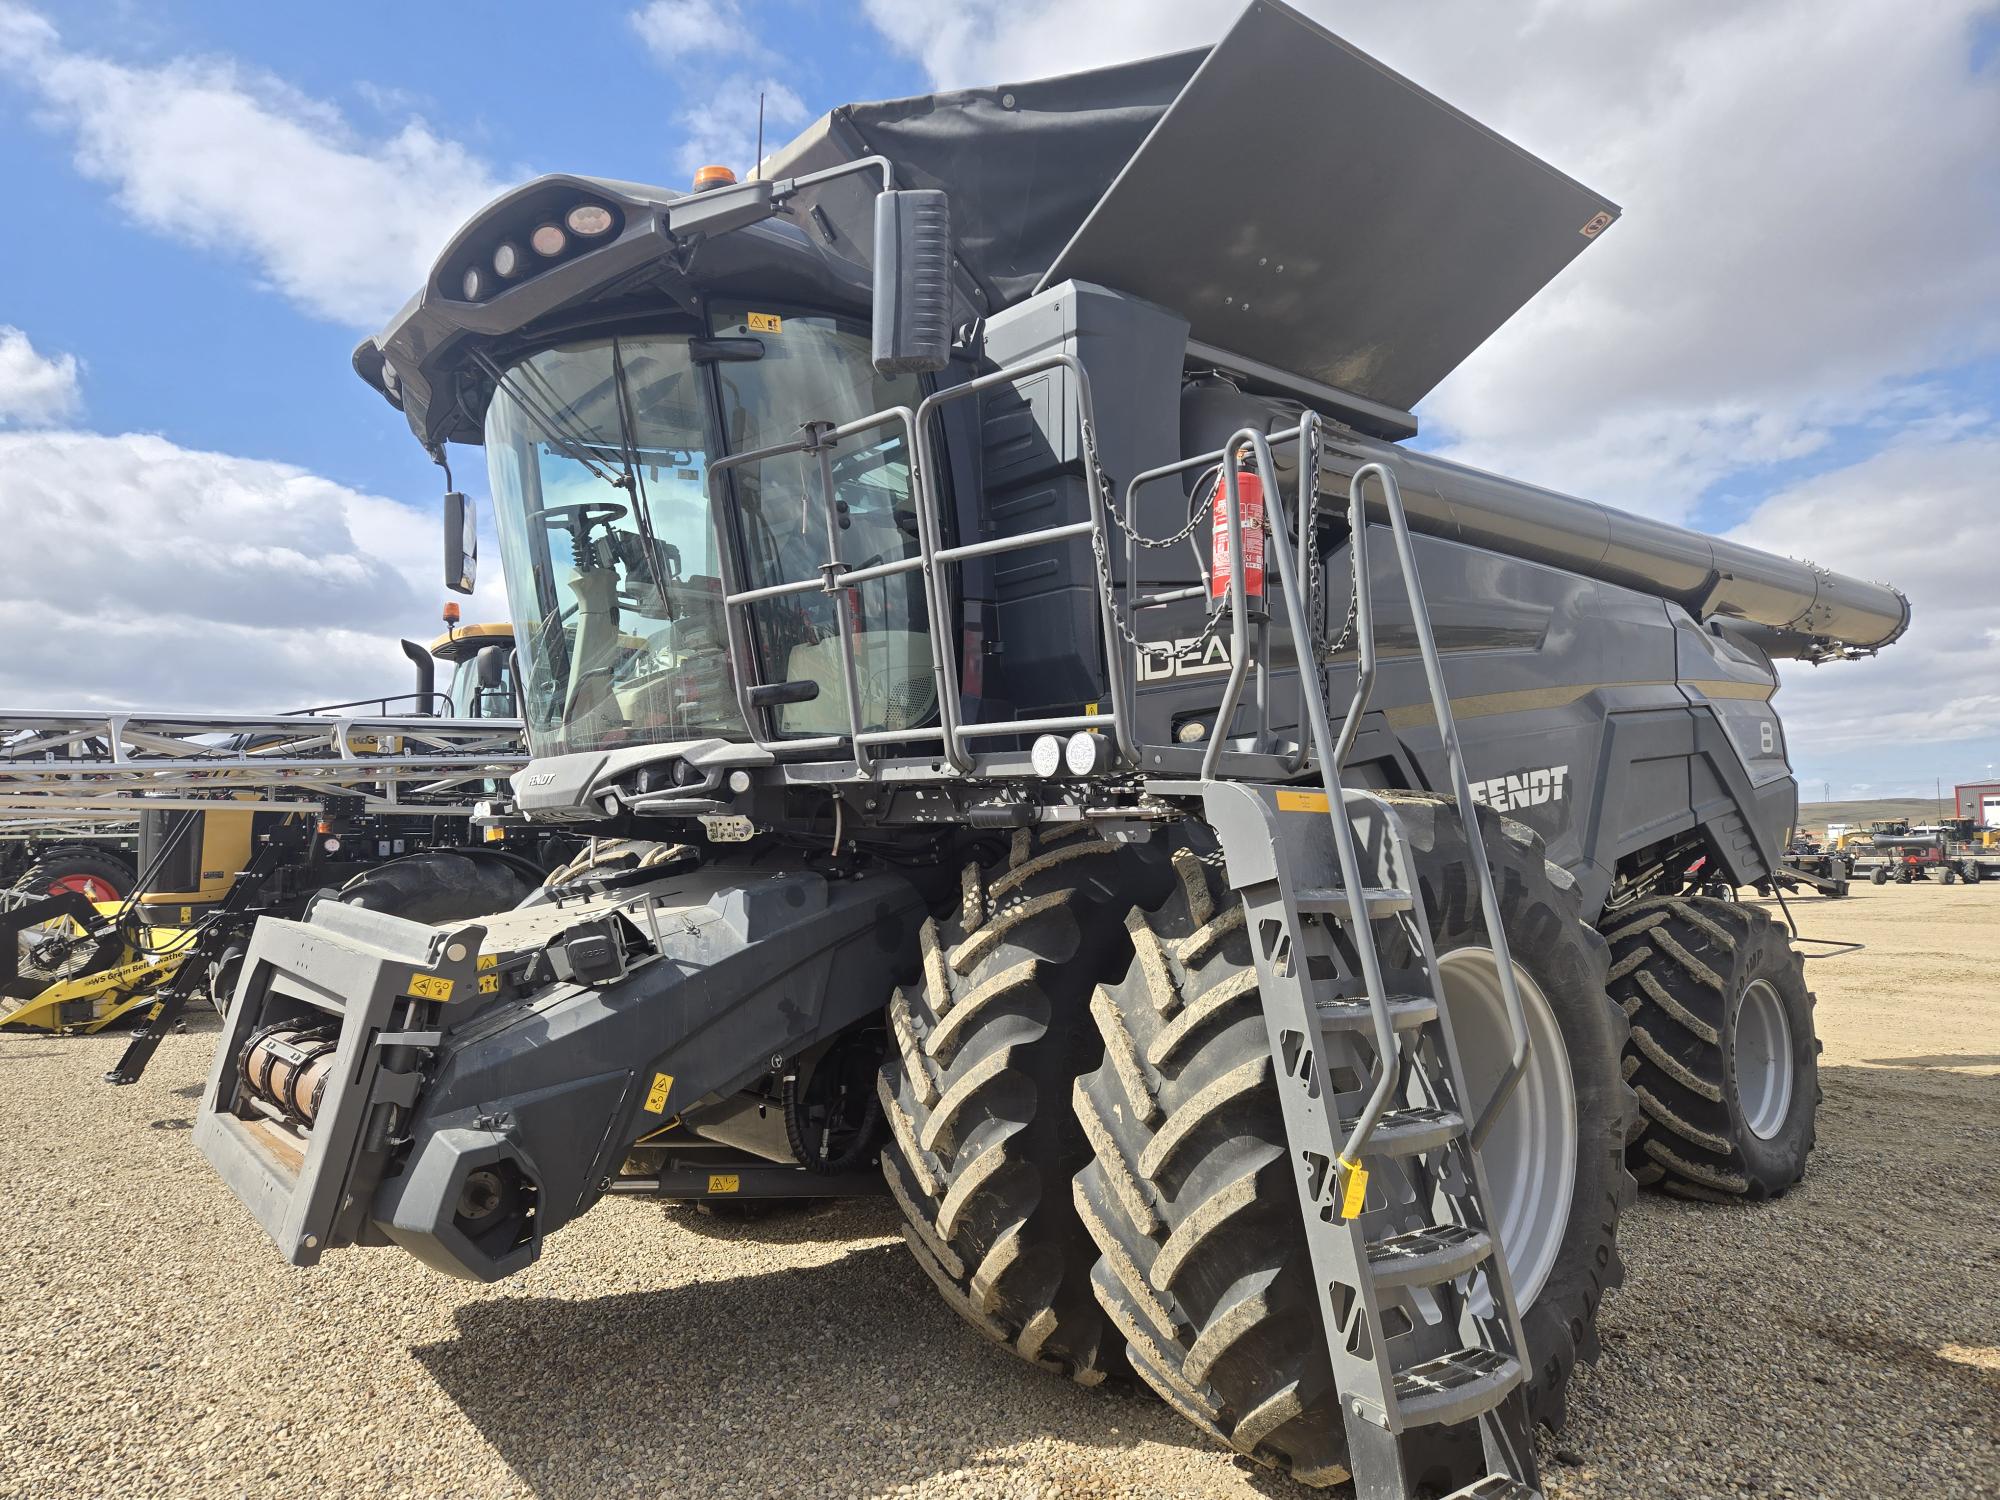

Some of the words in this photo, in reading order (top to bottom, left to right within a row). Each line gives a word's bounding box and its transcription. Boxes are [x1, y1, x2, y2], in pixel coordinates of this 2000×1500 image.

[1760, 721, 1773, 753] 8
[528, 773, 556, 786] FENDT
[1468, 765, 1569, 813] FENDT
[107, 967, 131, 981] Grain
[132, 961, 150, 972] Belt
[154, 951, 183, 966] wathe
